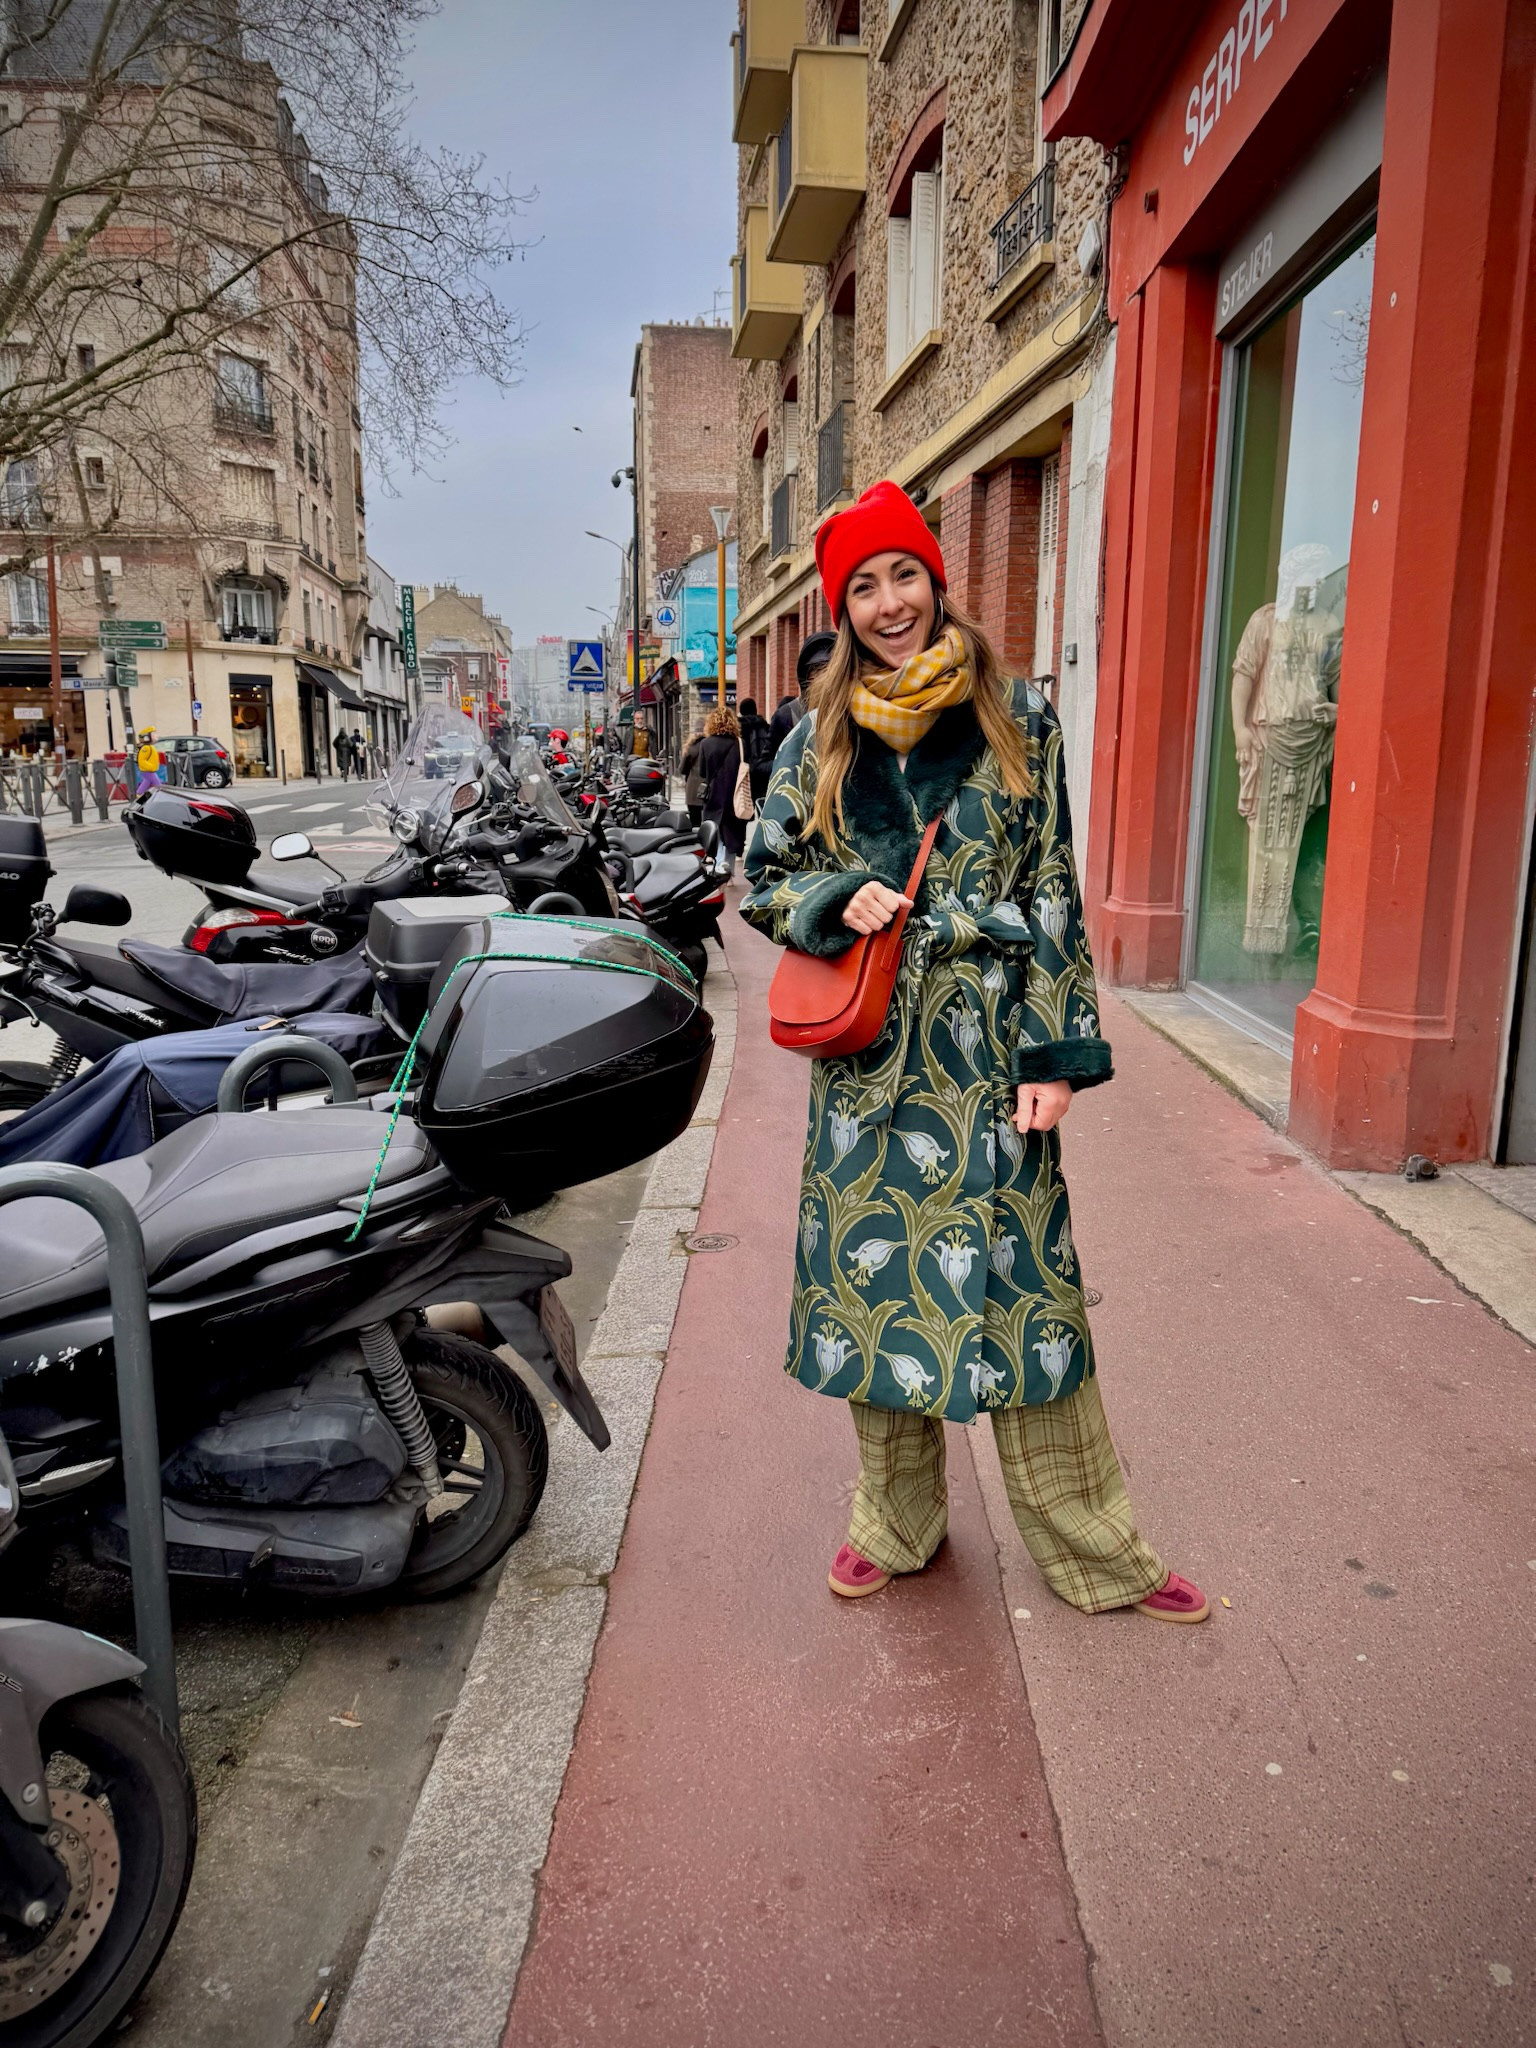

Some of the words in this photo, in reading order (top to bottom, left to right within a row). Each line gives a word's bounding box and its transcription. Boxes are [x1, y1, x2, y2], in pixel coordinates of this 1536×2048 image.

[1183, 0, 1288, 166] SERPE
[403, 588, 413, 630] MARCHE
[406, 633, 416, 668] CAMBO
